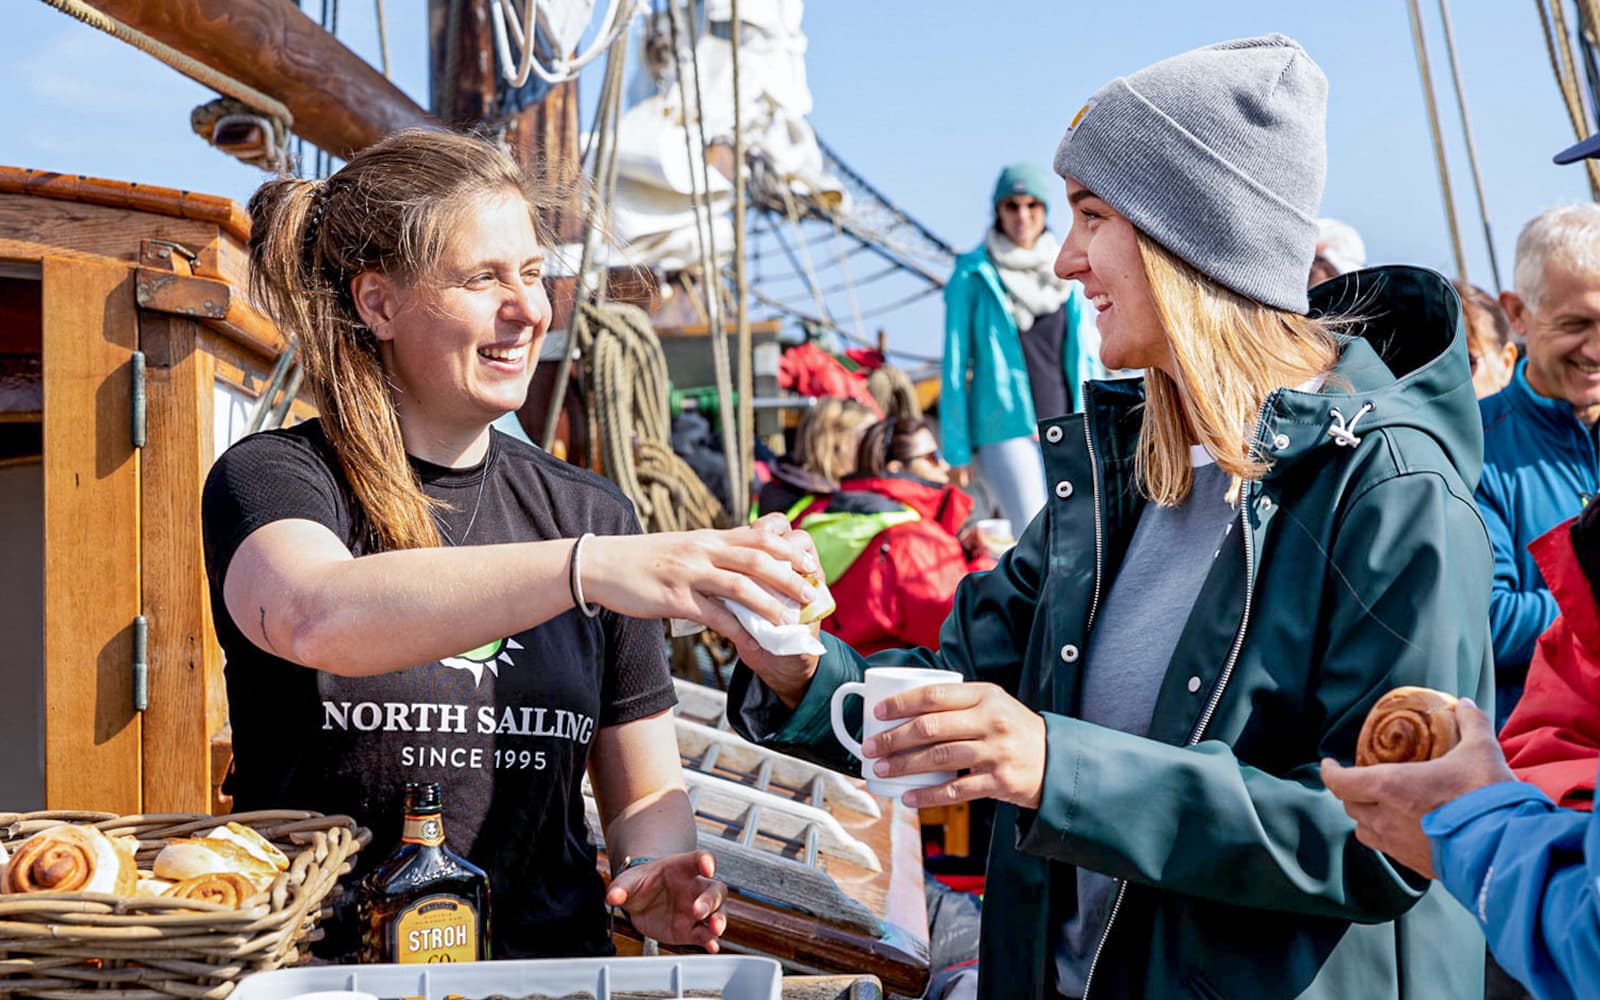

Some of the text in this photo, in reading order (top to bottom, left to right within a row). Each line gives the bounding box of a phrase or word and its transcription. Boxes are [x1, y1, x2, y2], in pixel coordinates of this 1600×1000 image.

[322, 701, 594, 745] NORTH SAILING
[402, 746, 547, 770] SINCE 1995
[408, 924, 467, 952] STROH
